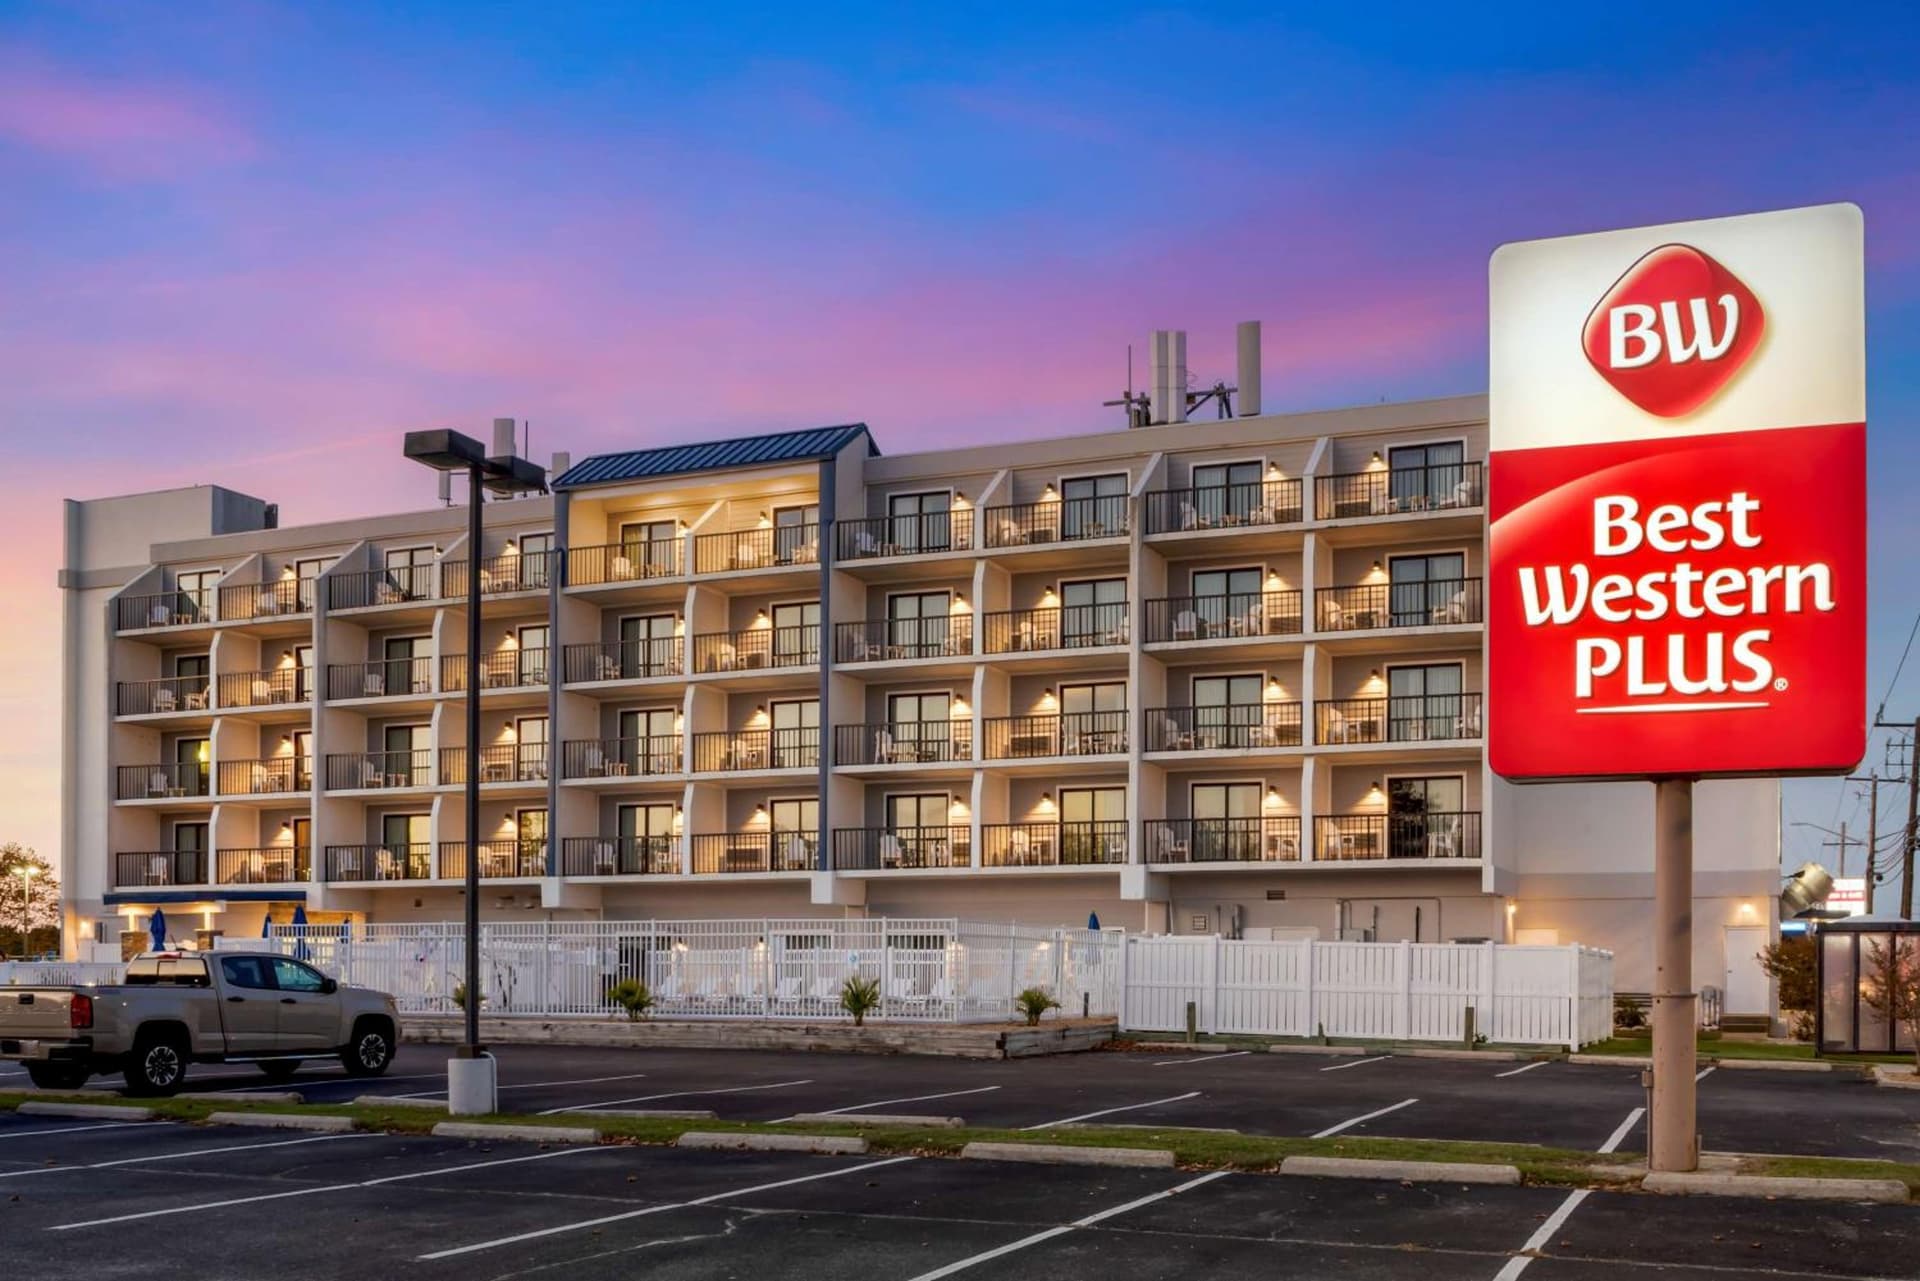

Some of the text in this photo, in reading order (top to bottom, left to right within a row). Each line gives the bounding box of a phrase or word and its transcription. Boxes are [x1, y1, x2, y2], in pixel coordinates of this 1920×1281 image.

[1609, 293, 1739, 369] BW
[1593, 492, 1762, 556] Best
[1518, 562, 1835, 626] Western
[1575, 629, 1773, 698] PLUS
